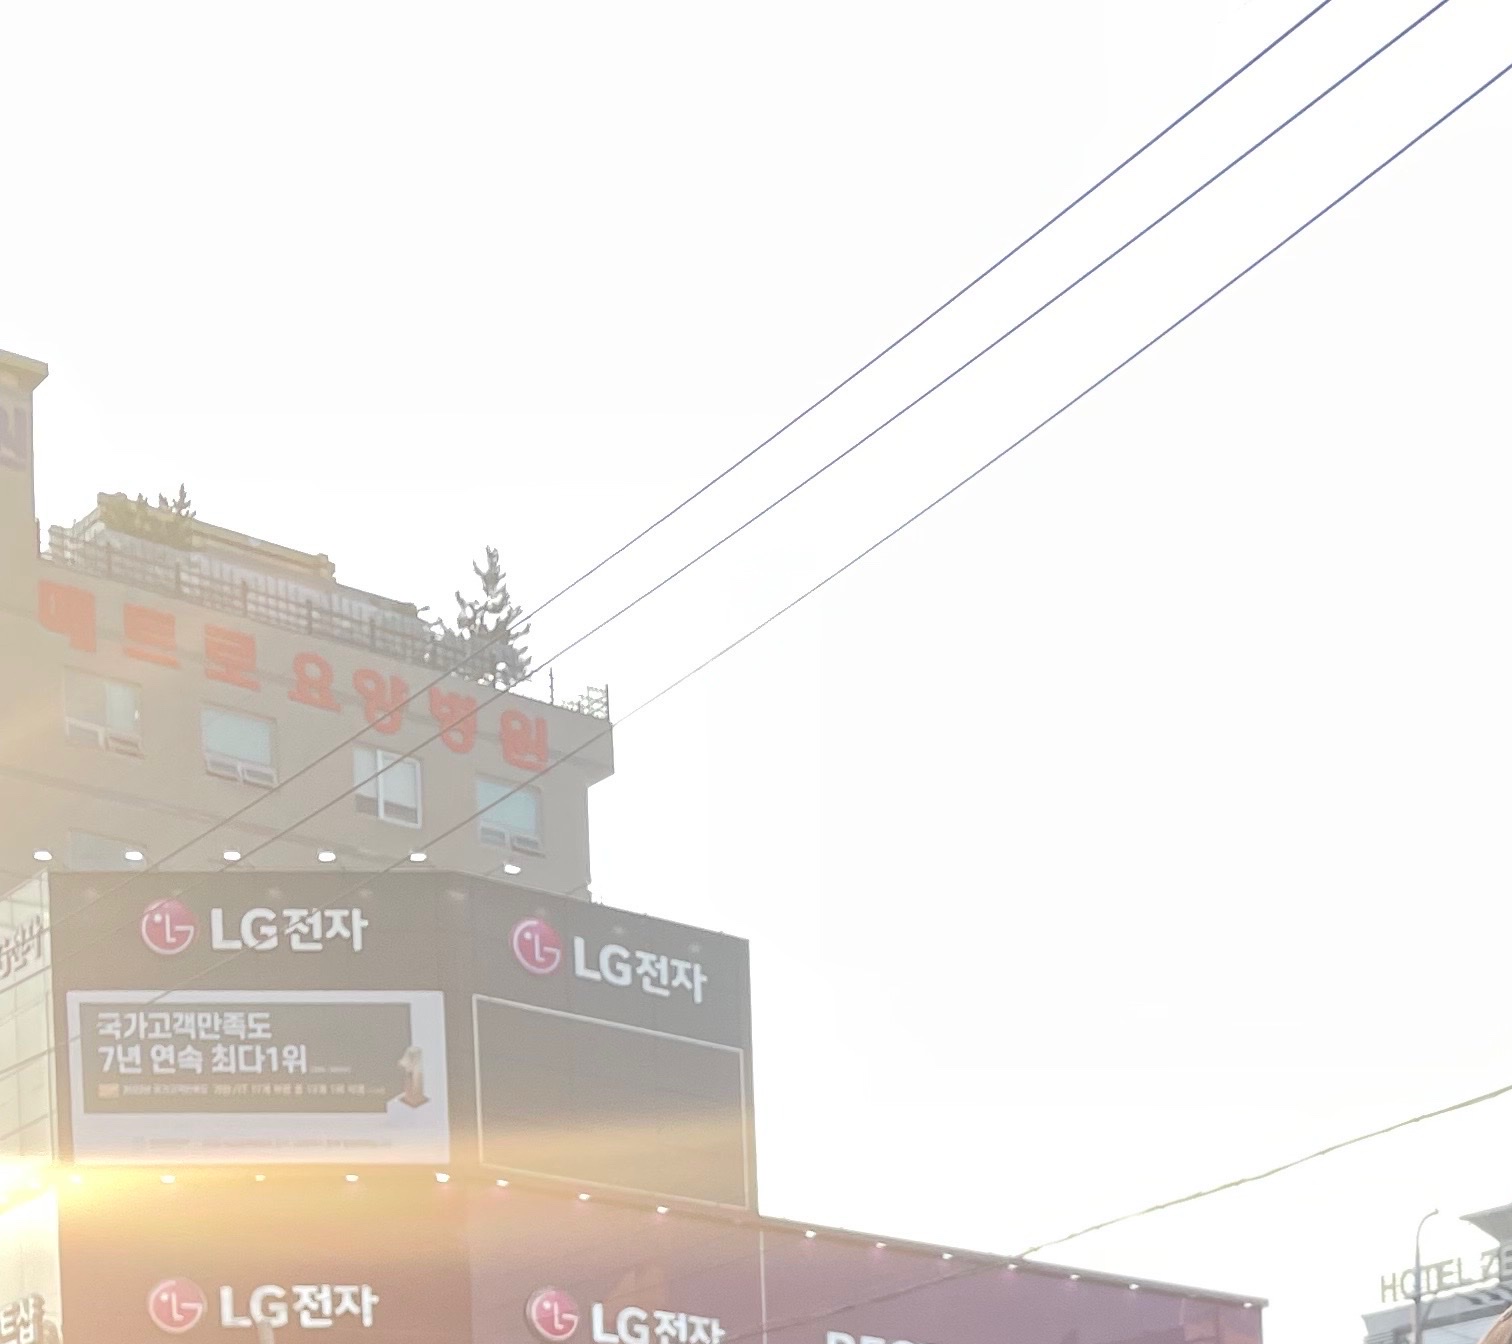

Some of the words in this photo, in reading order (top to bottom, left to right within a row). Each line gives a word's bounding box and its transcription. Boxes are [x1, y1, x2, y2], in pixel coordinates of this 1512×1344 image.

[211, 905, 369, 953] LG전자
[573, 935, 708, 1005] LG전자
[98, 1012, 272, 1040] 국가고객만족도
[98, 1044, 142, 1074] 7년
[151, 1044, 204, 1074] 연속
[211, 1044, 308, 1074] 최다1위
[1381, 1258, 1468, 1303] HOTEL
[220, 1284, 379, 1329] LG전자
